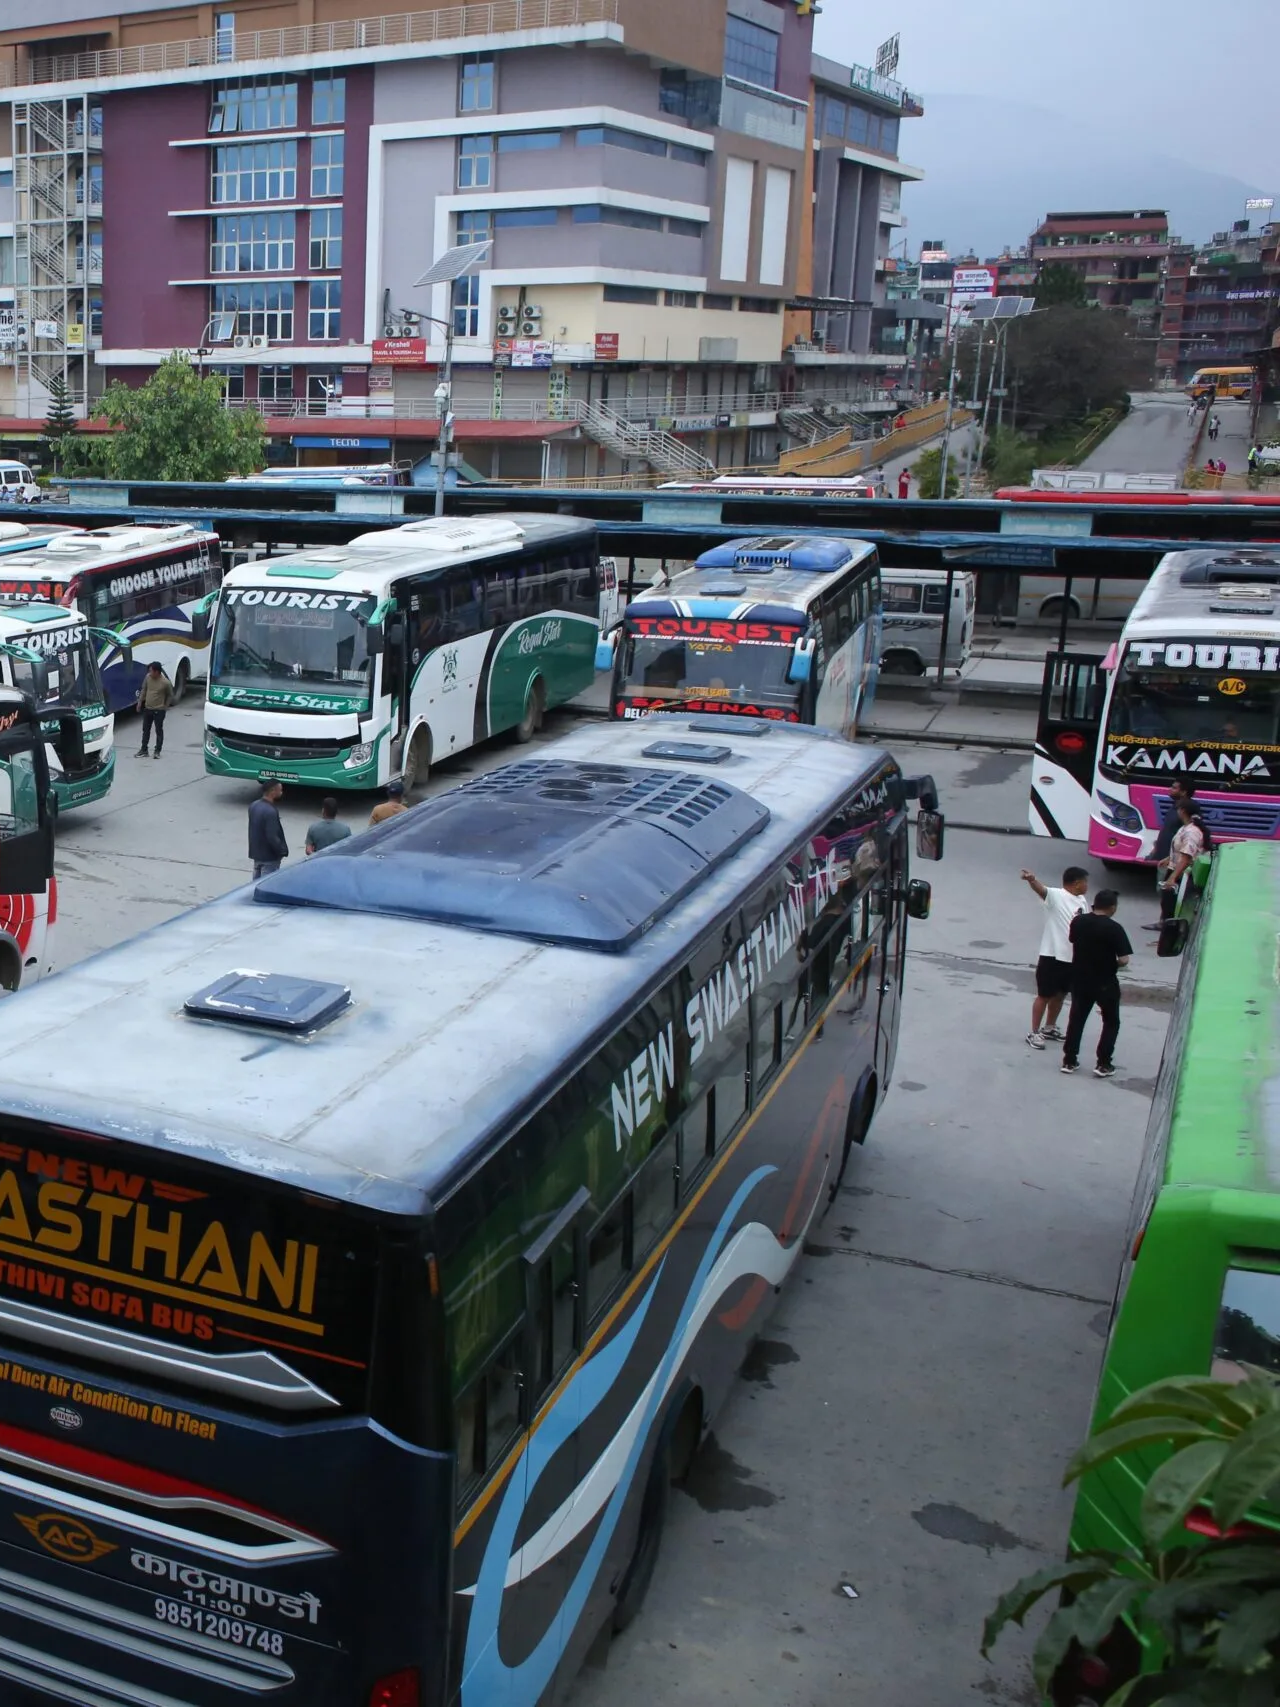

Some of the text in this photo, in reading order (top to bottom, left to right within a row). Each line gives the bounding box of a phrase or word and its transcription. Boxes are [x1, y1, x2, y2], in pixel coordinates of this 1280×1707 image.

[329, 438, 360, 447] TECNO
[110, 555, 210, 598] CHOOSE YOUR BEST
[226, 590, 369, 612] TOURIST
[12, 625, 89, 653] TOURIST
[632, 618, 801, 644] TOURIST
[687, 642, 734, 653] YATRA
[1129, 642, 1280, 672] TOURI
[1220, 679, 1245, 694] A/C
[79, 705, 104, 720] Star
[292, 694, 346, 711] Star
[631, 697, 762, 716] SAEENA
[1106, 744, 1271, 777] KAMANA
[611, 1022, 674, 1153] NEW
[686, 882, 806, 1066] SWASTHANI
[27, 1150, 147, 1200] NEW
[72, 1280, 144, 1323] SOFA
[152, 1304, 215, 1340] BUS
[11, 1365, 46, 1392] Duct
[47, 1377, 71, 1398] Air
[71, 1381, 148, 1422] Condition
[151, 1405, 173, 1428] On
[175, 1411, 217, 1442] Fleet
[42, 1525, 88, 1551] AC
[182, 1589, 247, 1617] 11:00
[155, 1598, 284, 1656] 9851209748
